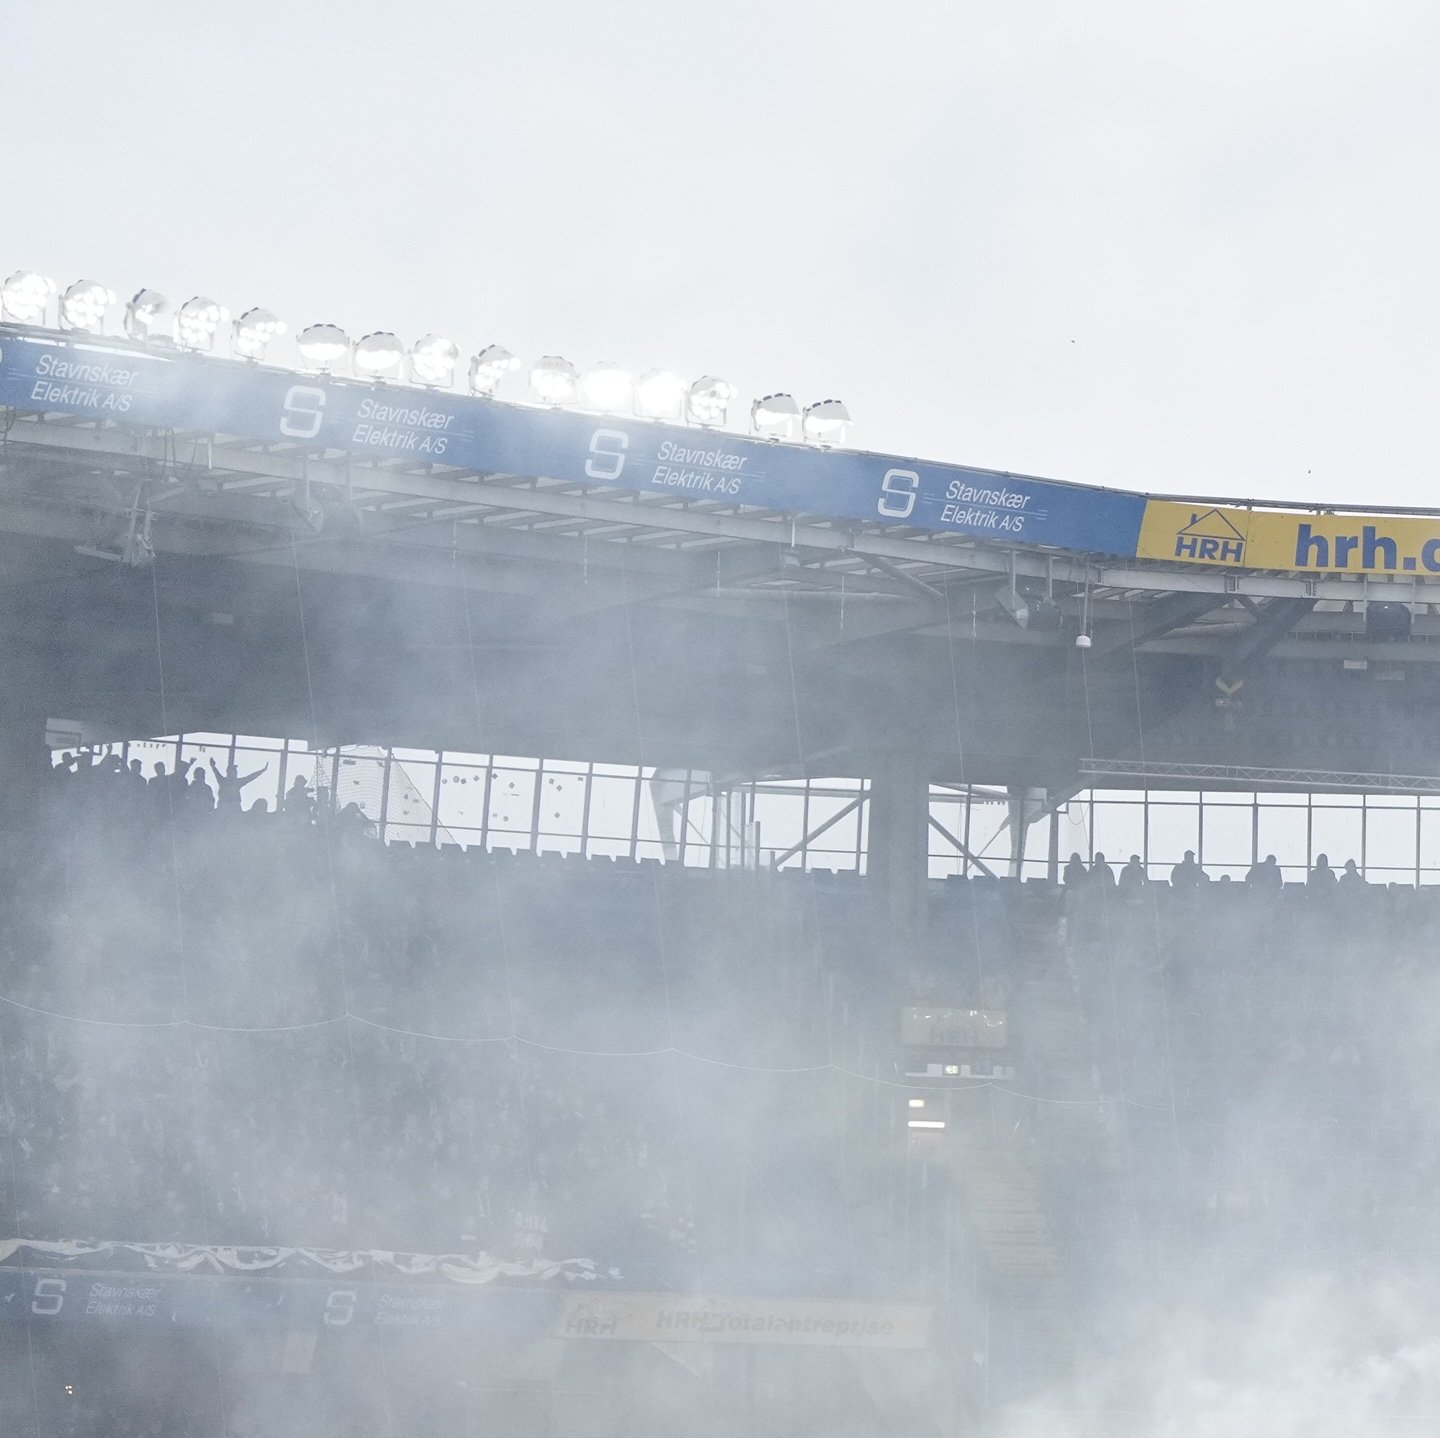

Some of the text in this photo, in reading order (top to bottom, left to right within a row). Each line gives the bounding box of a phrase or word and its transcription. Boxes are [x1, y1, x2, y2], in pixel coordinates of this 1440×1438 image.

[36, 355, 139, 386] Stavnskær
[31, 380, 133, 412] Elektrik A/S
[357, 399, 455, 430] Stavnskær
[352, 424, 449, 455] Elektrik A/S
[658, 441, 748, 471] Stavnskær
[652, 466, 742, 494] Elektrik A/S
[945, 481, 1031, 508] Stavnskær
[940, 504, 1025, 532] Elektrik A/S
[1174, 537, 1243, 563] HRH
